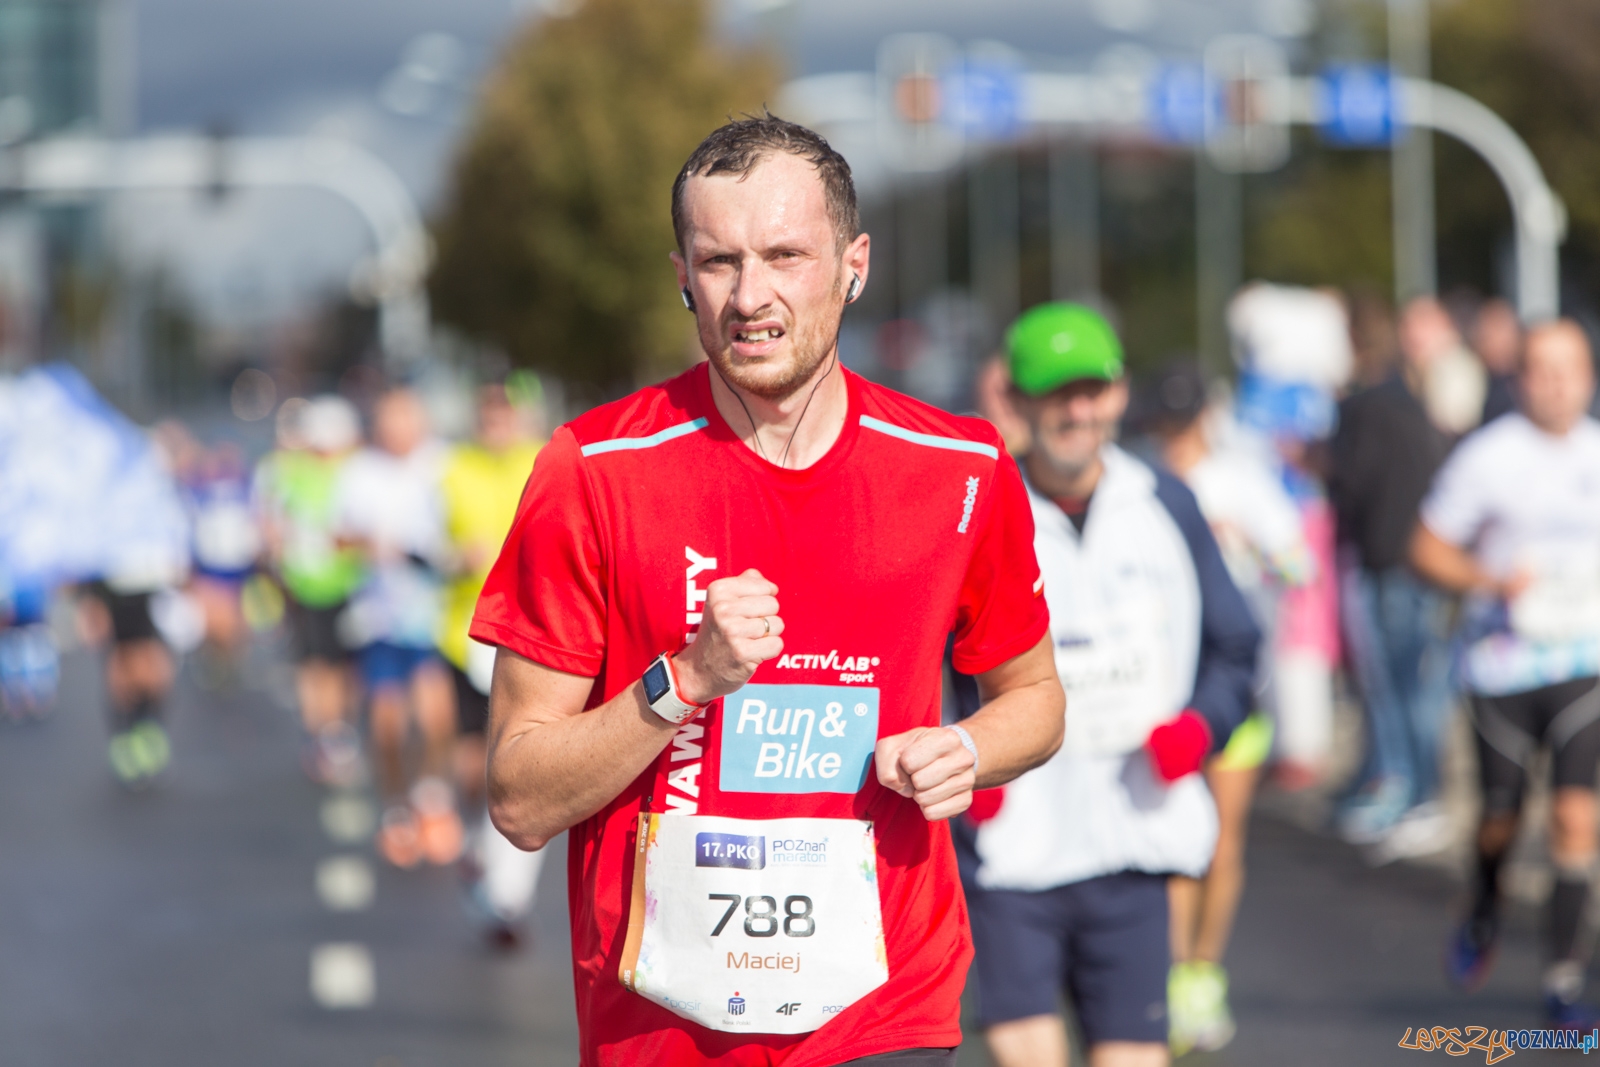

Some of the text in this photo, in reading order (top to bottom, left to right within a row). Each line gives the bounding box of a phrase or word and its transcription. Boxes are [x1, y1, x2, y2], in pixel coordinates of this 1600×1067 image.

[957, 475, 980, 534] Reebok
[839, 672, 874, 684] sport
[754, 742, 842, 779] Bike
[727, 843, 760, 860] PKO
[773, 852, 827, 863] maraton
[708, 893, 816, 938] 788
[727, 952, 801, 973] Maciej
[776, 1002, 802, 1015] 4F
